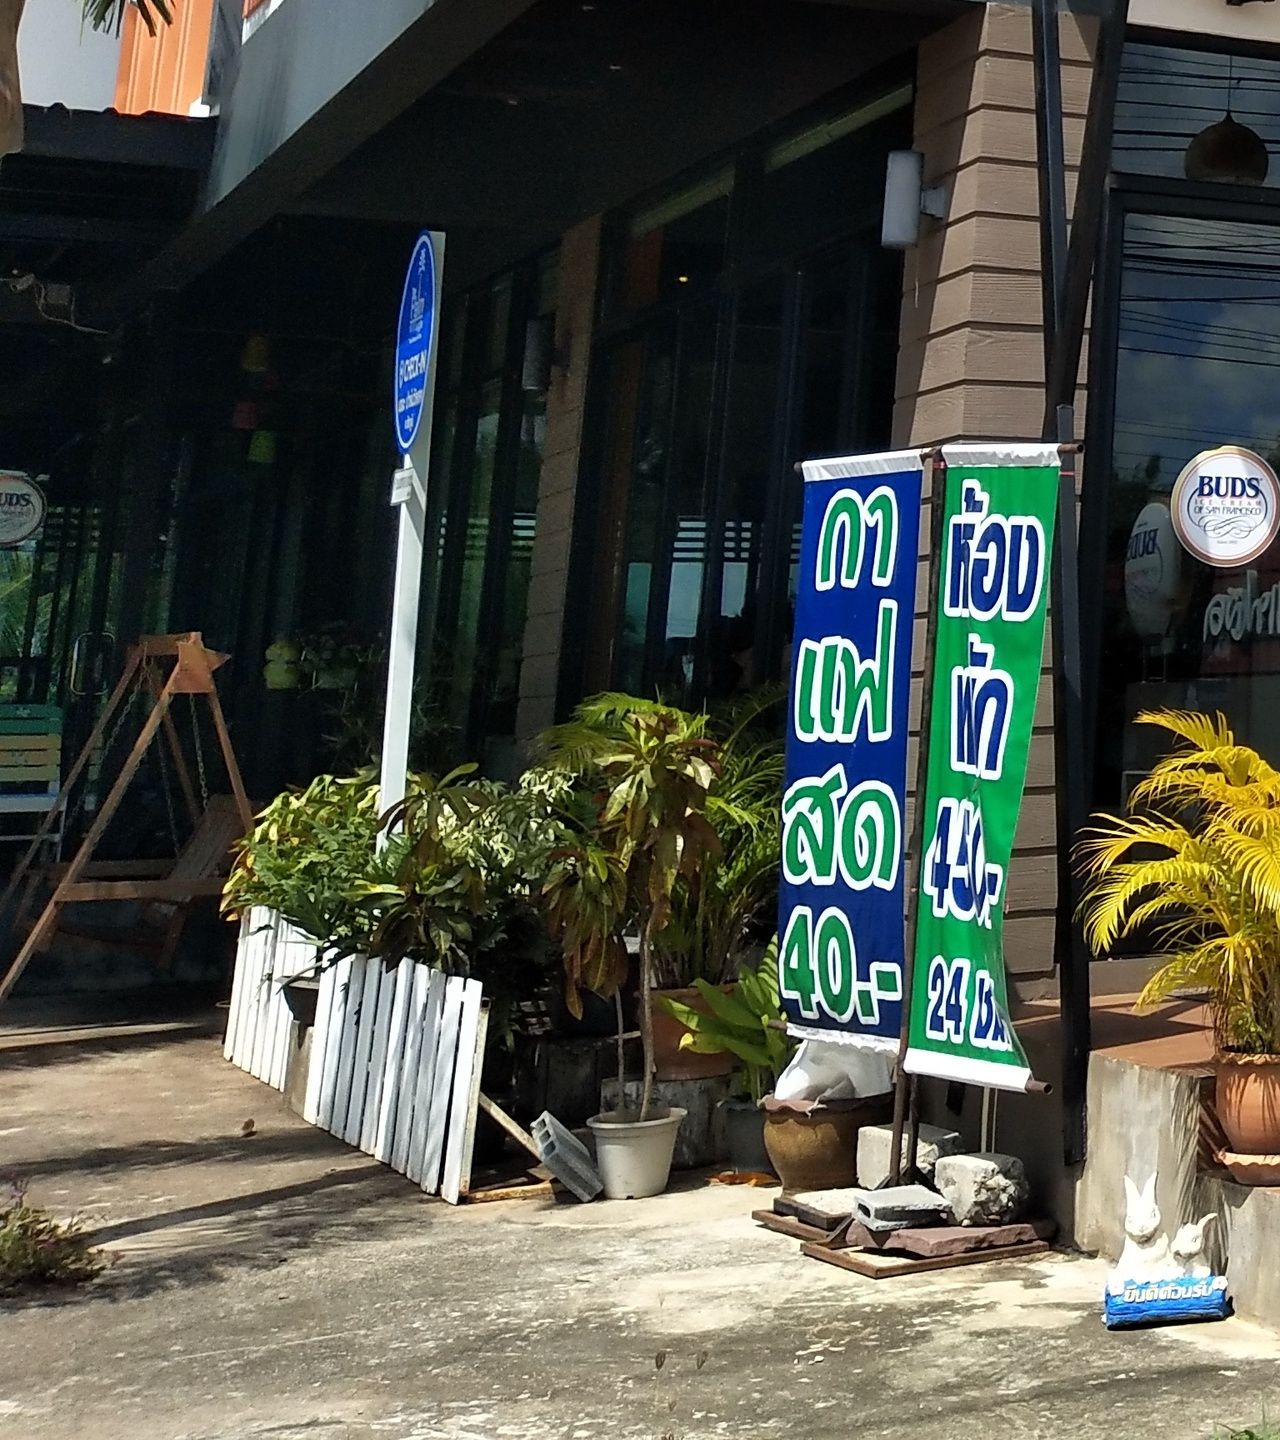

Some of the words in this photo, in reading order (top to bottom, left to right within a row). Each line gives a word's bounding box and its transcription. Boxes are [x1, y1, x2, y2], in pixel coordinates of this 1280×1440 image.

[814, 486, 898, 591] กา
[944, 479, 1045, 621] ห้อง
[795, 598, 898, 742] แฟ
[782, 764, 900, 891] สด
[926, 954, 970, 1044] 24
